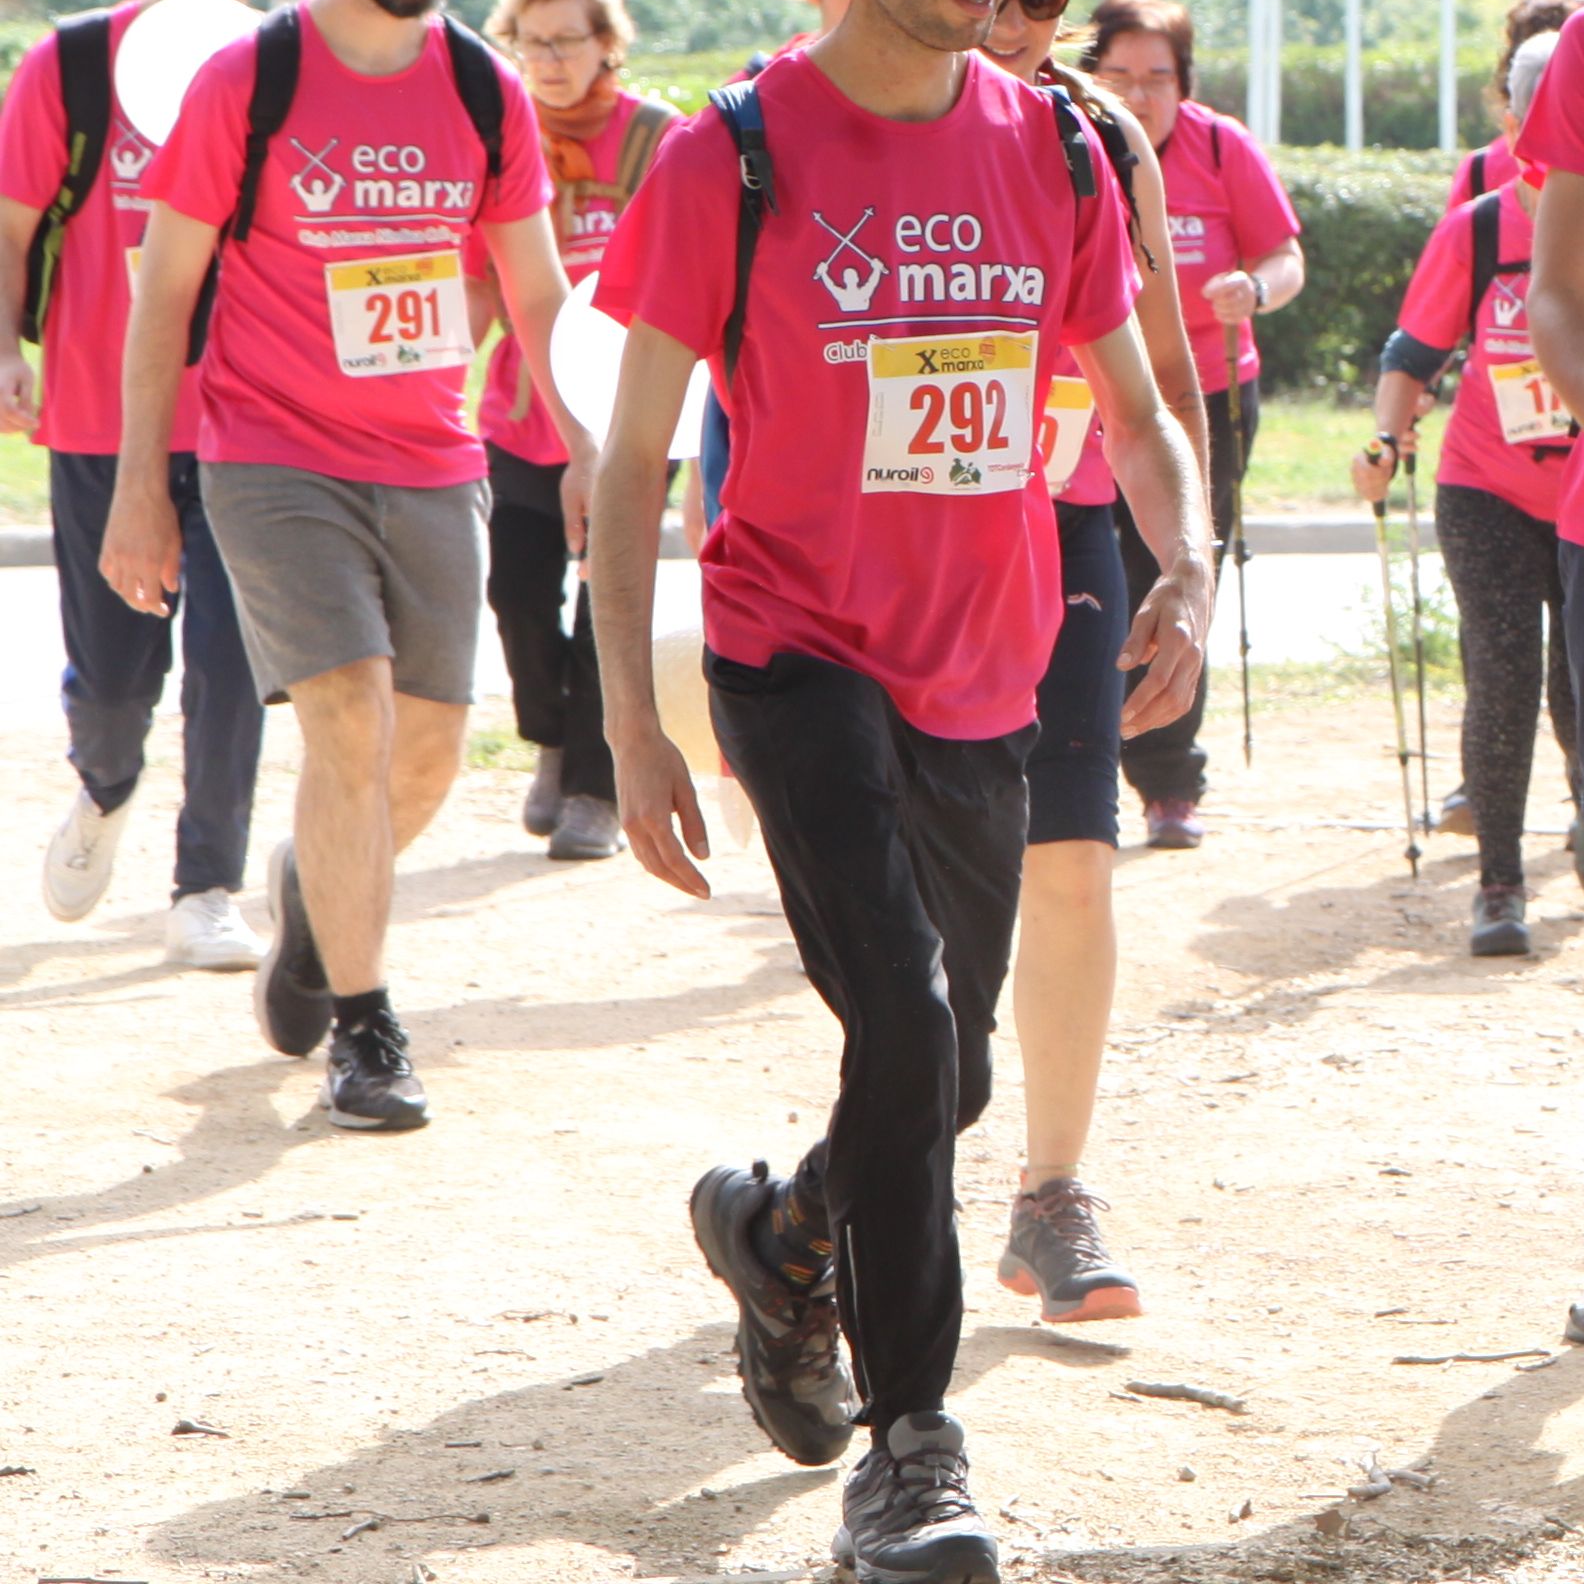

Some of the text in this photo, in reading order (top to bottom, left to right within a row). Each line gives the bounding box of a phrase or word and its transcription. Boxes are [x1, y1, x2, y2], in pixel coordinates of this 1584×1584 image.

[352, 145, 426, 174] eco
[896, 213, 982, 253] eco
[366, 268, 383, 287] X
[899, 262, 1045, 306] marxa
[365, 287, 440, 344] 291
[824, 340, 868, 365] Club
[915, 348, 940, 375] X
[940, 346, 972, 360] eco
[941, 359, 985, 373] marxa
[908, 379, 1009, 455] 292
[867, 466, 918, 482] nuroil
